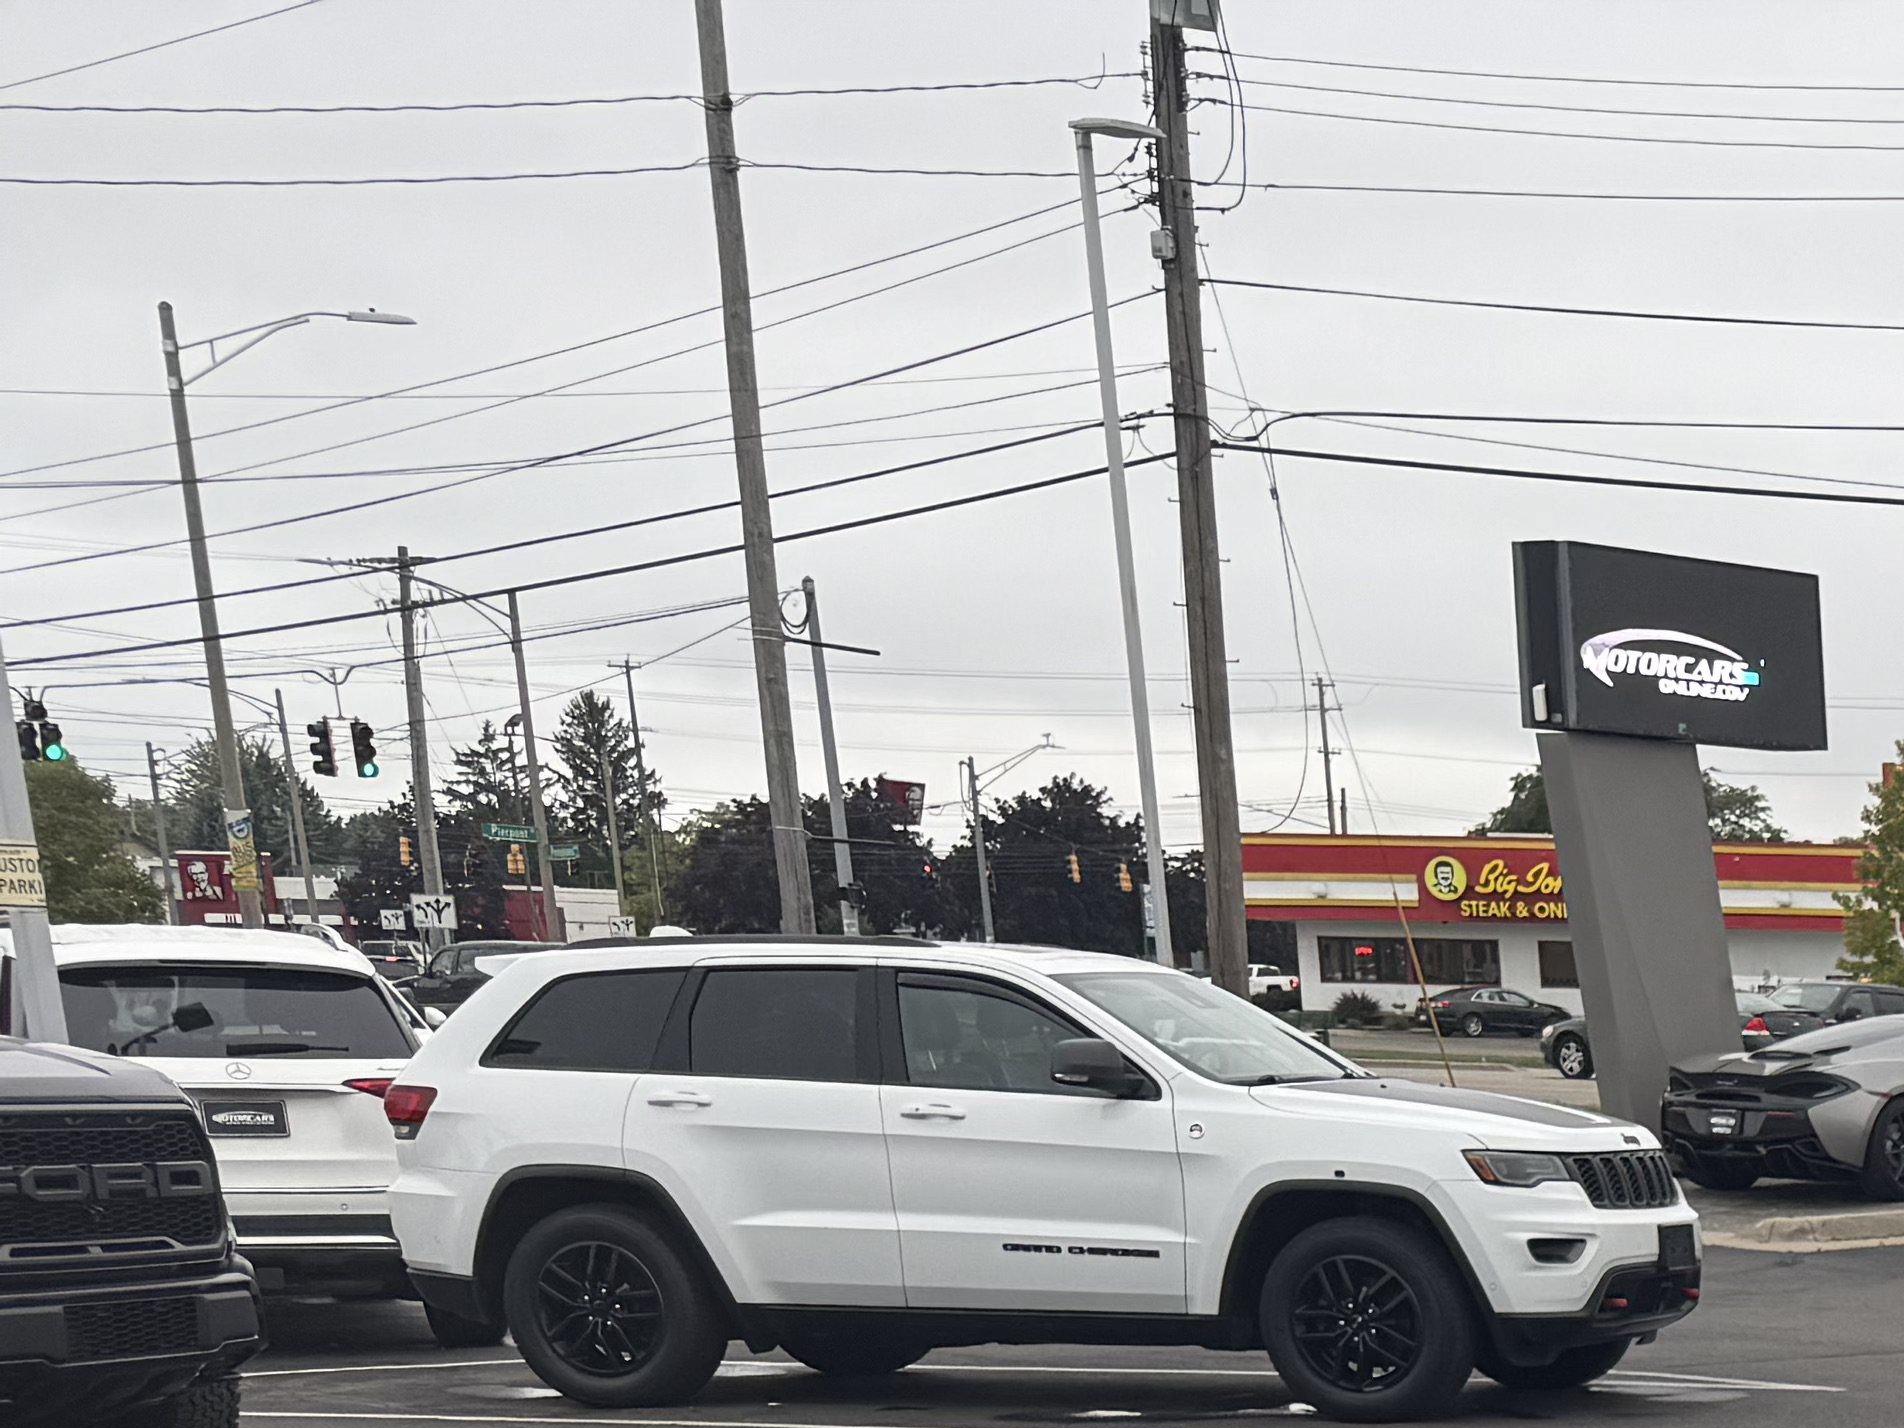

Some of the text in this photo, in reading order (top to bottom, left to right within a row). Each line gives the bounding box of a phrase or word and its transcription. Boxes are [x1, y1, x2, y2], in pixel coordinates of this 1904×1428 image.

[1581, 645, 1751, 688] MOTORCARS
[1475, 859, 1562, 898] Big Jo
[1460, 901, 1512, 917] STEAK
[1516, 902, 1530, 917] &
